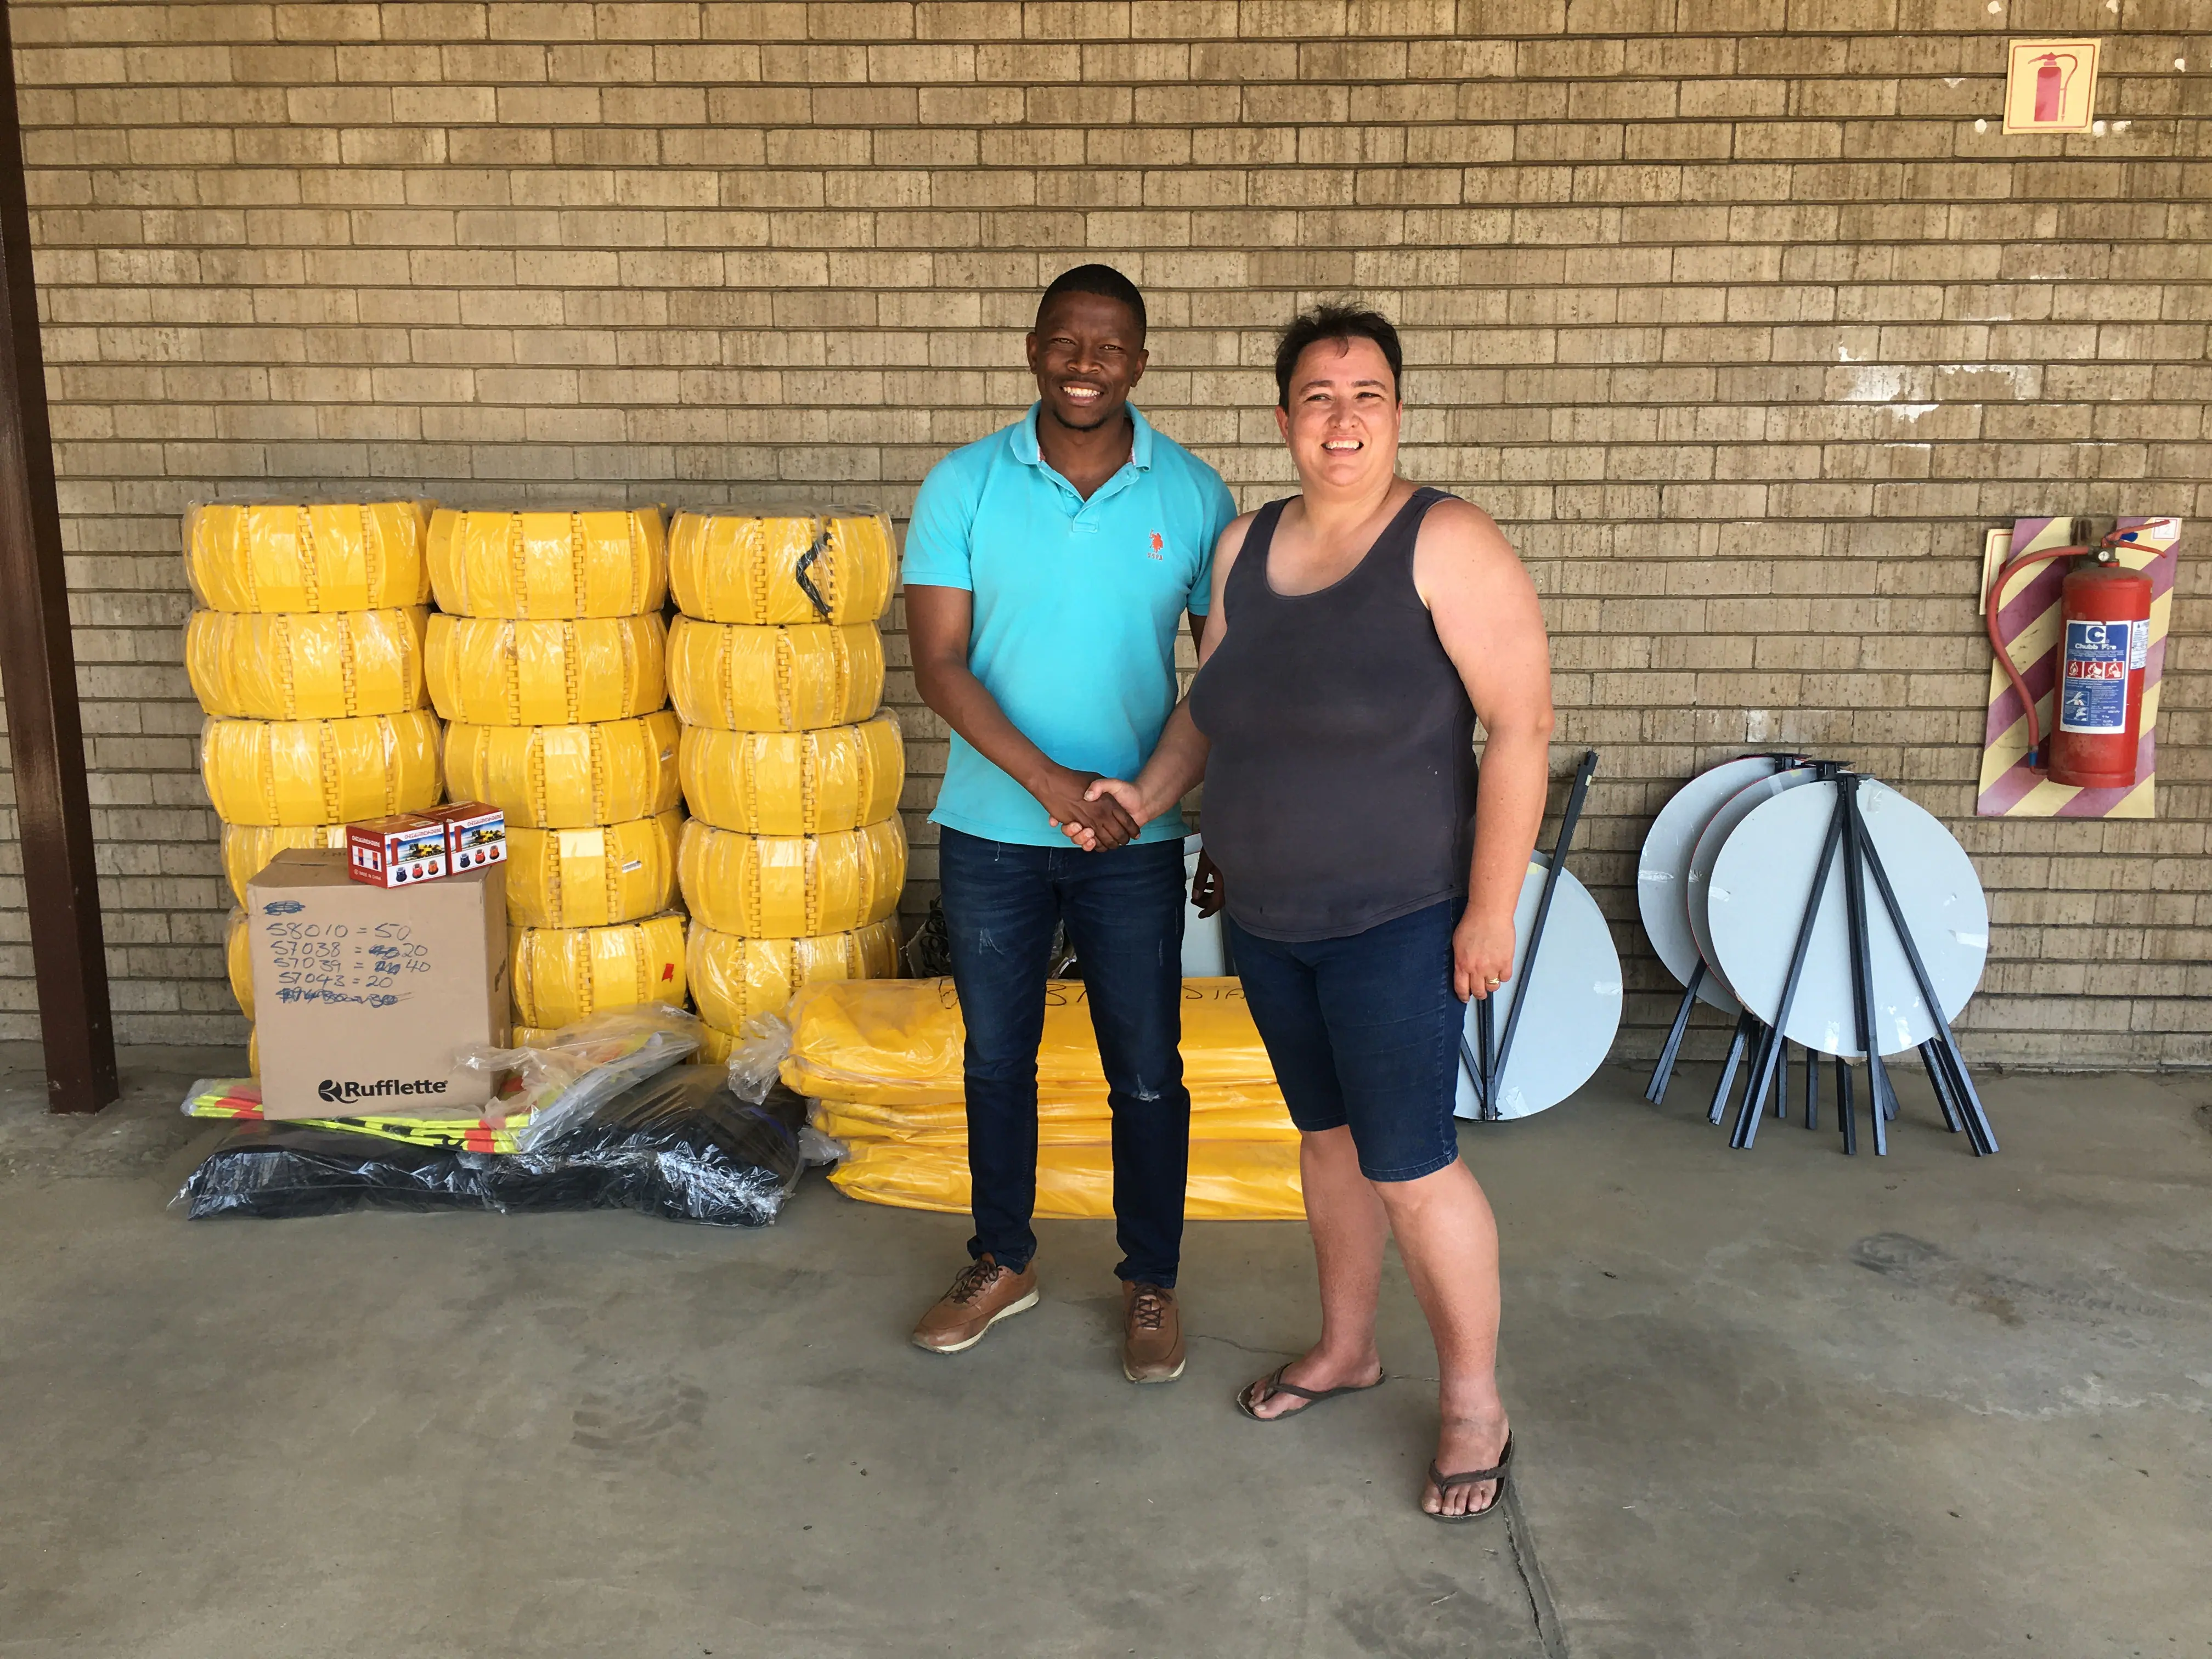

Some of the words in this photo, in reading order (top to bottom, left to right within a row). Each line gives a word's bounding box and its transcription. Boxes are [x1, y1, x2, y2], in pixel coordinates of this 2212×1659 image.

[266, 923, 348, 939] 58010
[375, 923, 411, 940] 50
[270, 940, 341, 957] 57038
[402, 943, 428, 957] 20
[274, 957, 341, 973] 57039
[405, 959, 431, 972] 40
[279, 972, 345, 988] 57043
[366, 975, 393, 988] 20
[345, 1080, 447, 1097] Rufflette
